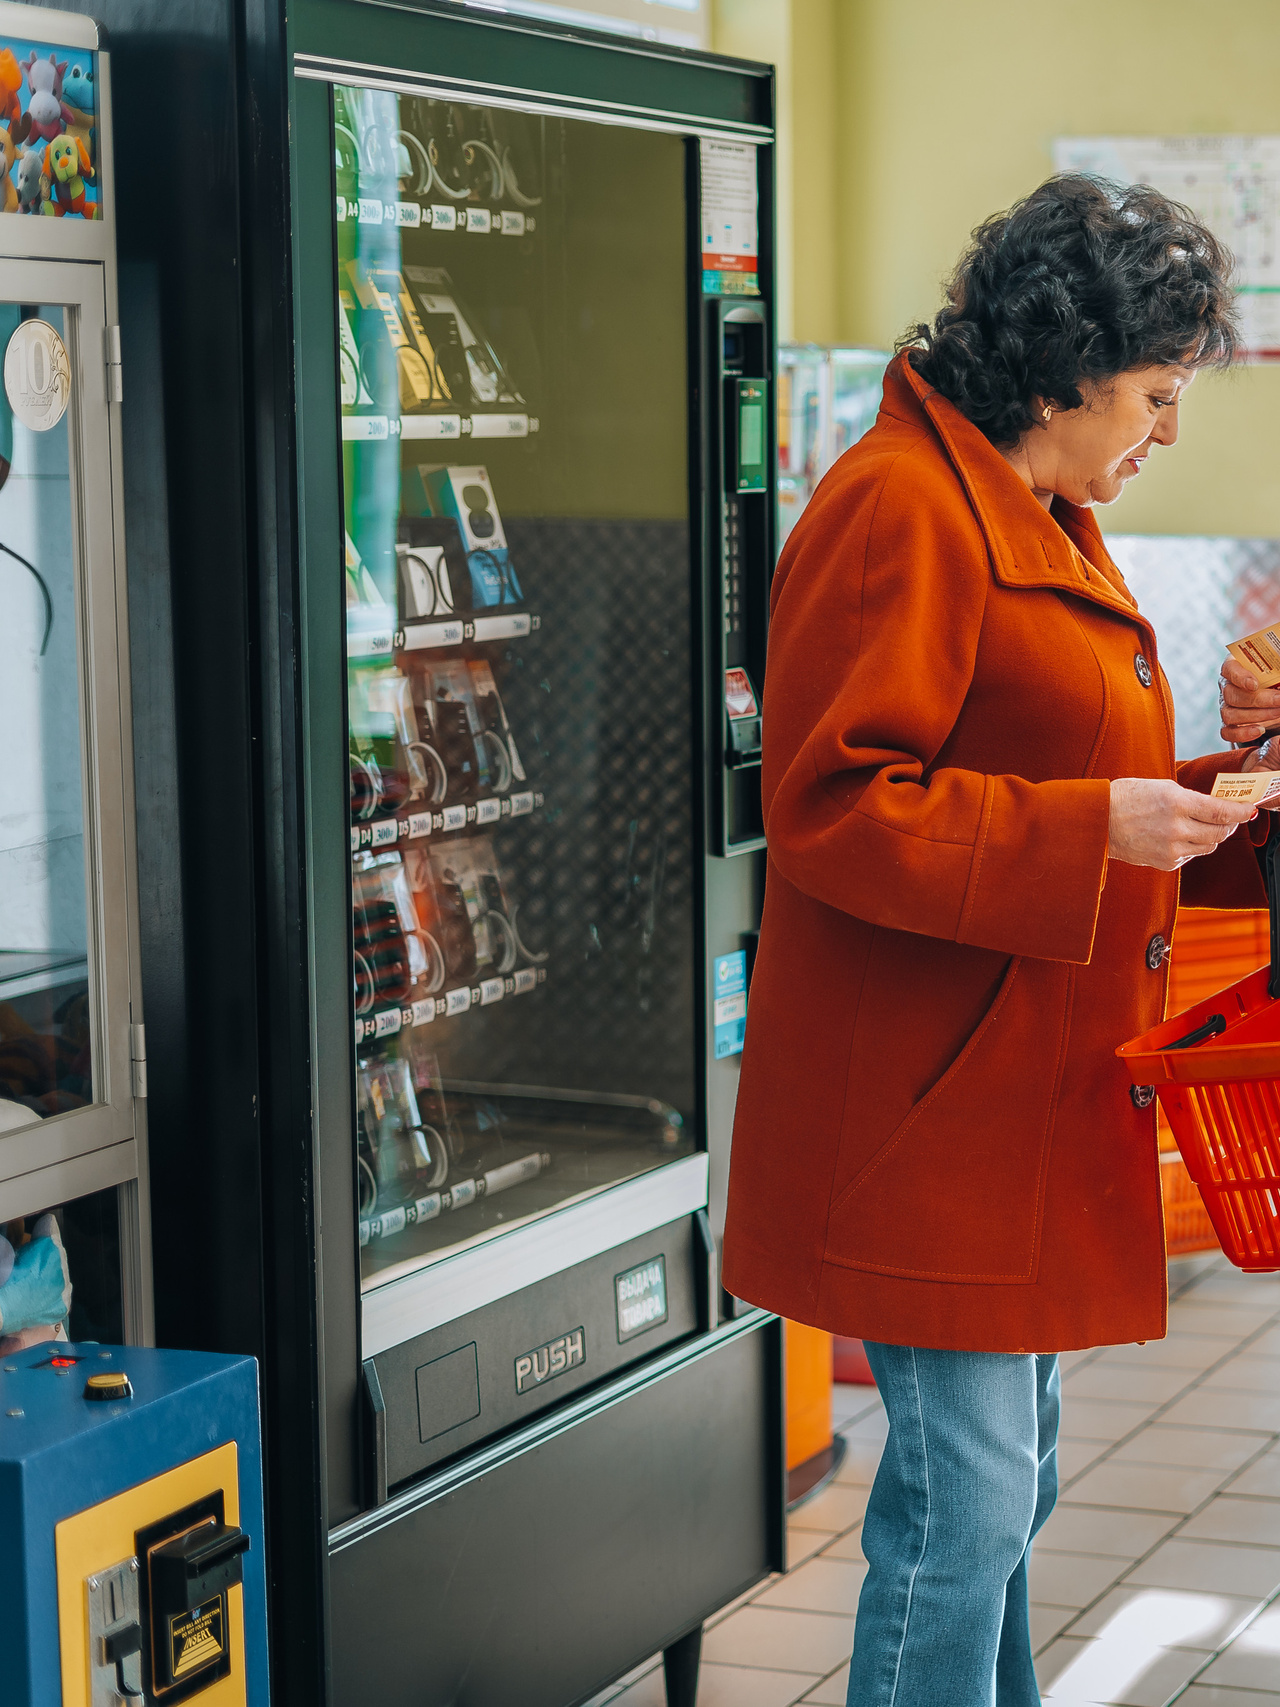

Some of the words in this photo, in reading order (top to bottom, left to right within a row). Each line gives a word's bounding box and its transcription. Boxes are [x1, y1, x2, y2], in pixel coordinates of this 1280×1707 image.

[12, 338, 51, 395] 10
[1225, 789, 1238, 797] 872
[1238, 789, 1253, 797] ДНЯ
[619, 1265, 662, 1301] ВЫДАЧА
[621, 1295, 662, 1332] ТОВАРА
[516, 1331, 583, 1389] PUSH
[173, 1626, 186, 1637] INSERT
[186, 1622, 194, 1630] BILL
[194, 1617, 202, 1626] ANY
[201, 1608, 220, 1621] DIRECTION
[184, 1627, 211, 1650] INSERT
[195, 1622, 204, 1631] FOLD
[204, 1618, 213, 1626] BILL
